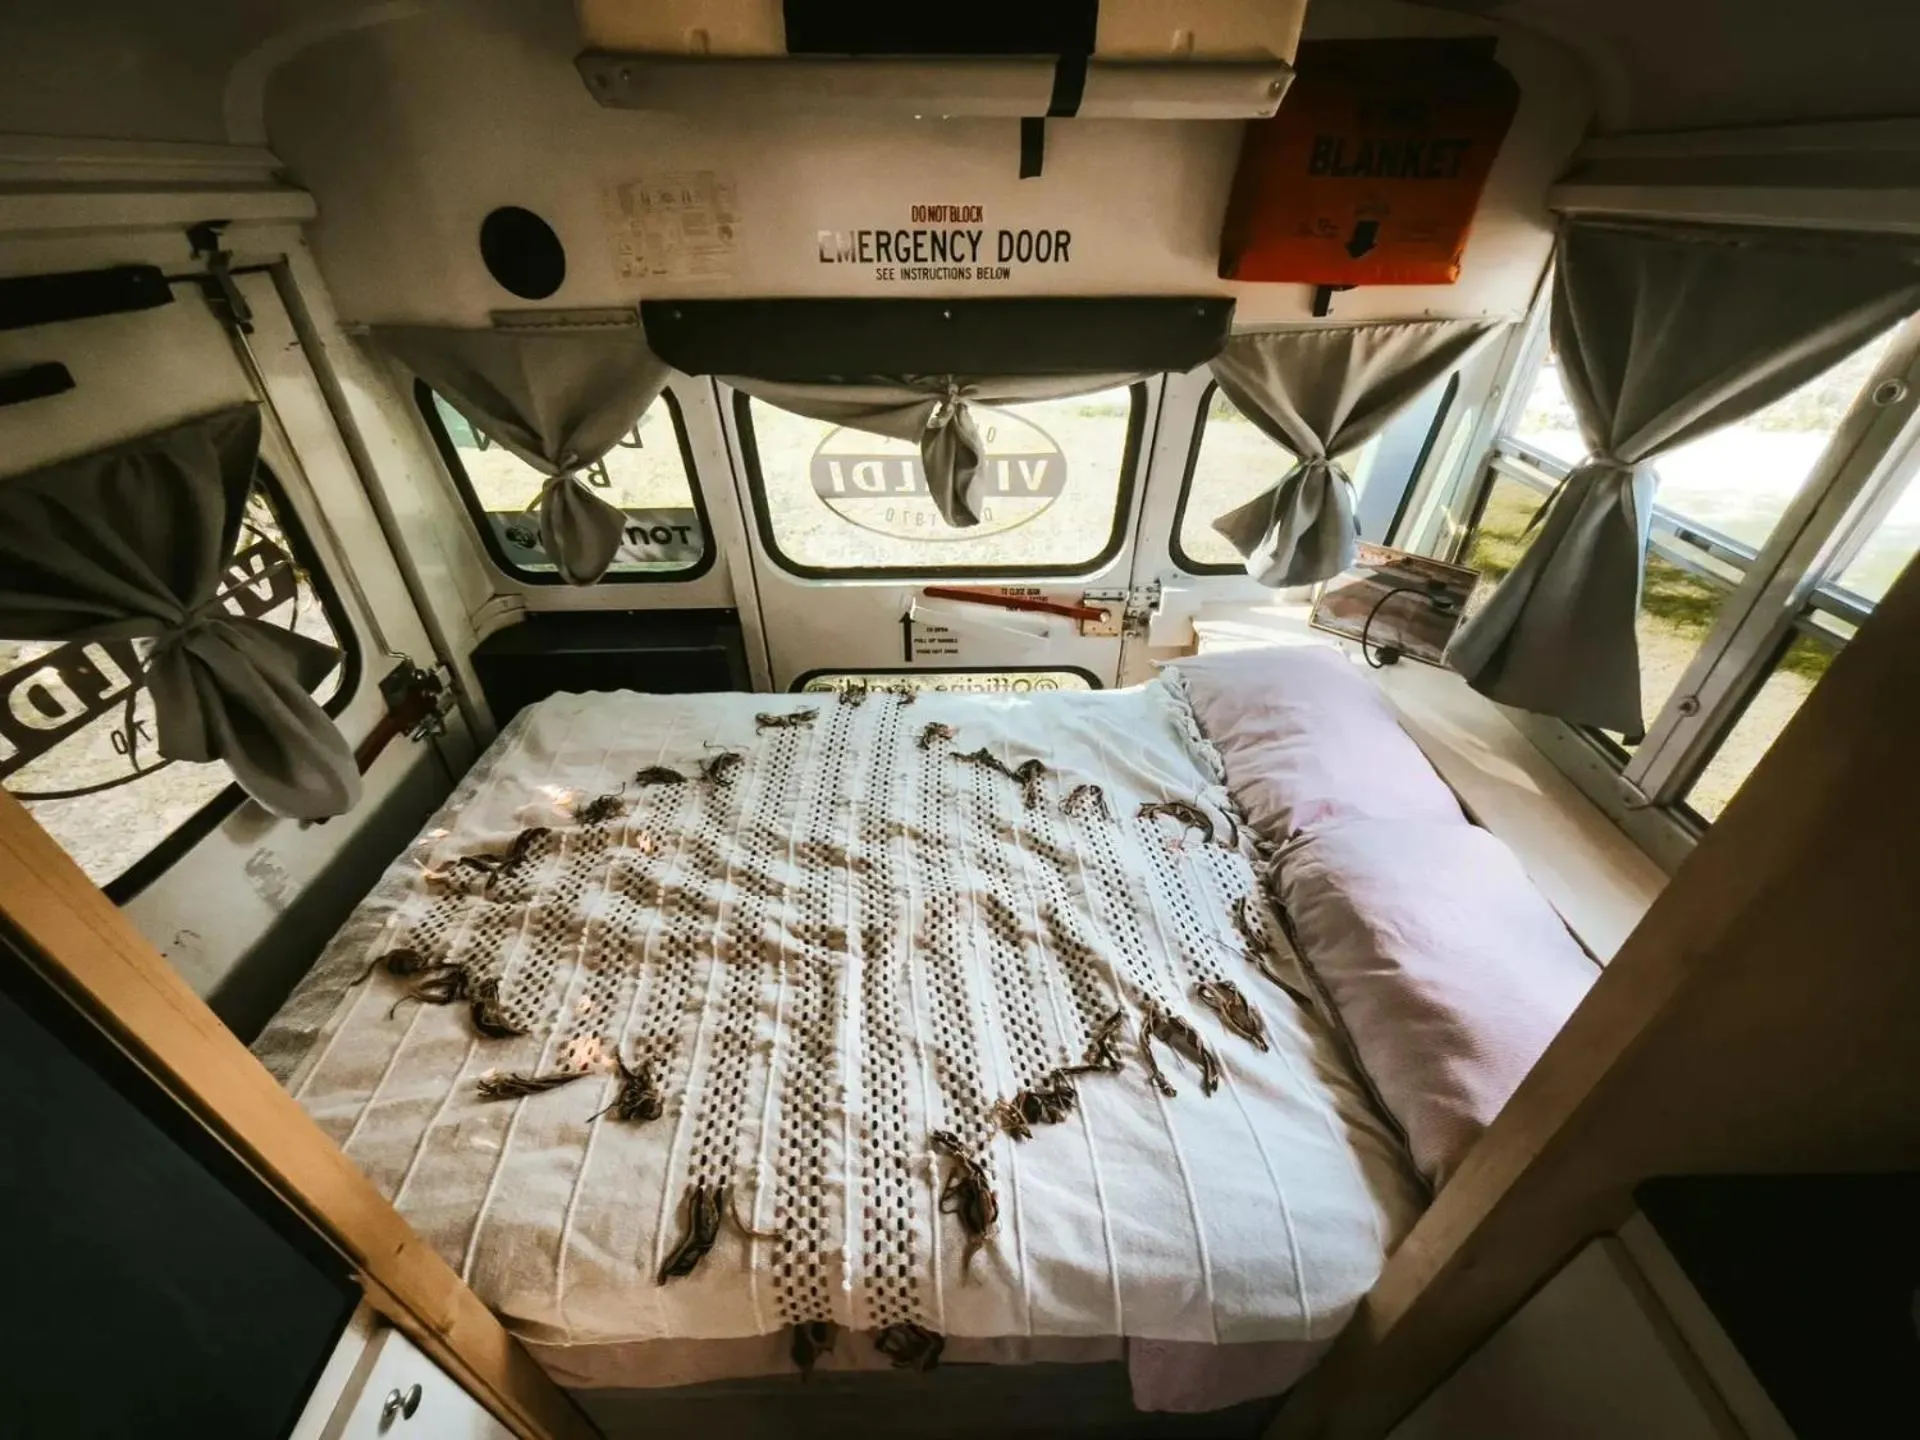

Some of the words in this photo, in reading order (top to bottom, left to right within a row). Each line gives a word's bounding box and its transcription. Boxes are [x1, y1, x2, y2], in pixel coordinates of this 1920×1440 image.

[1309, 134, 1472, 178] BLANKET
[911, 205, 926, 223] DO
[928, 205, 947, 223] NOT
[949, 205, 983, 223] BLOCK
[818, 229, 982, 263] EMERGENCY
[998, 229, 1072, 263] DOOR
[876, 267, 895, 281] SEE
[900, 267, 972, 281] INSTRUCTIONS
[976, 267, 1010, 281] BELOW
